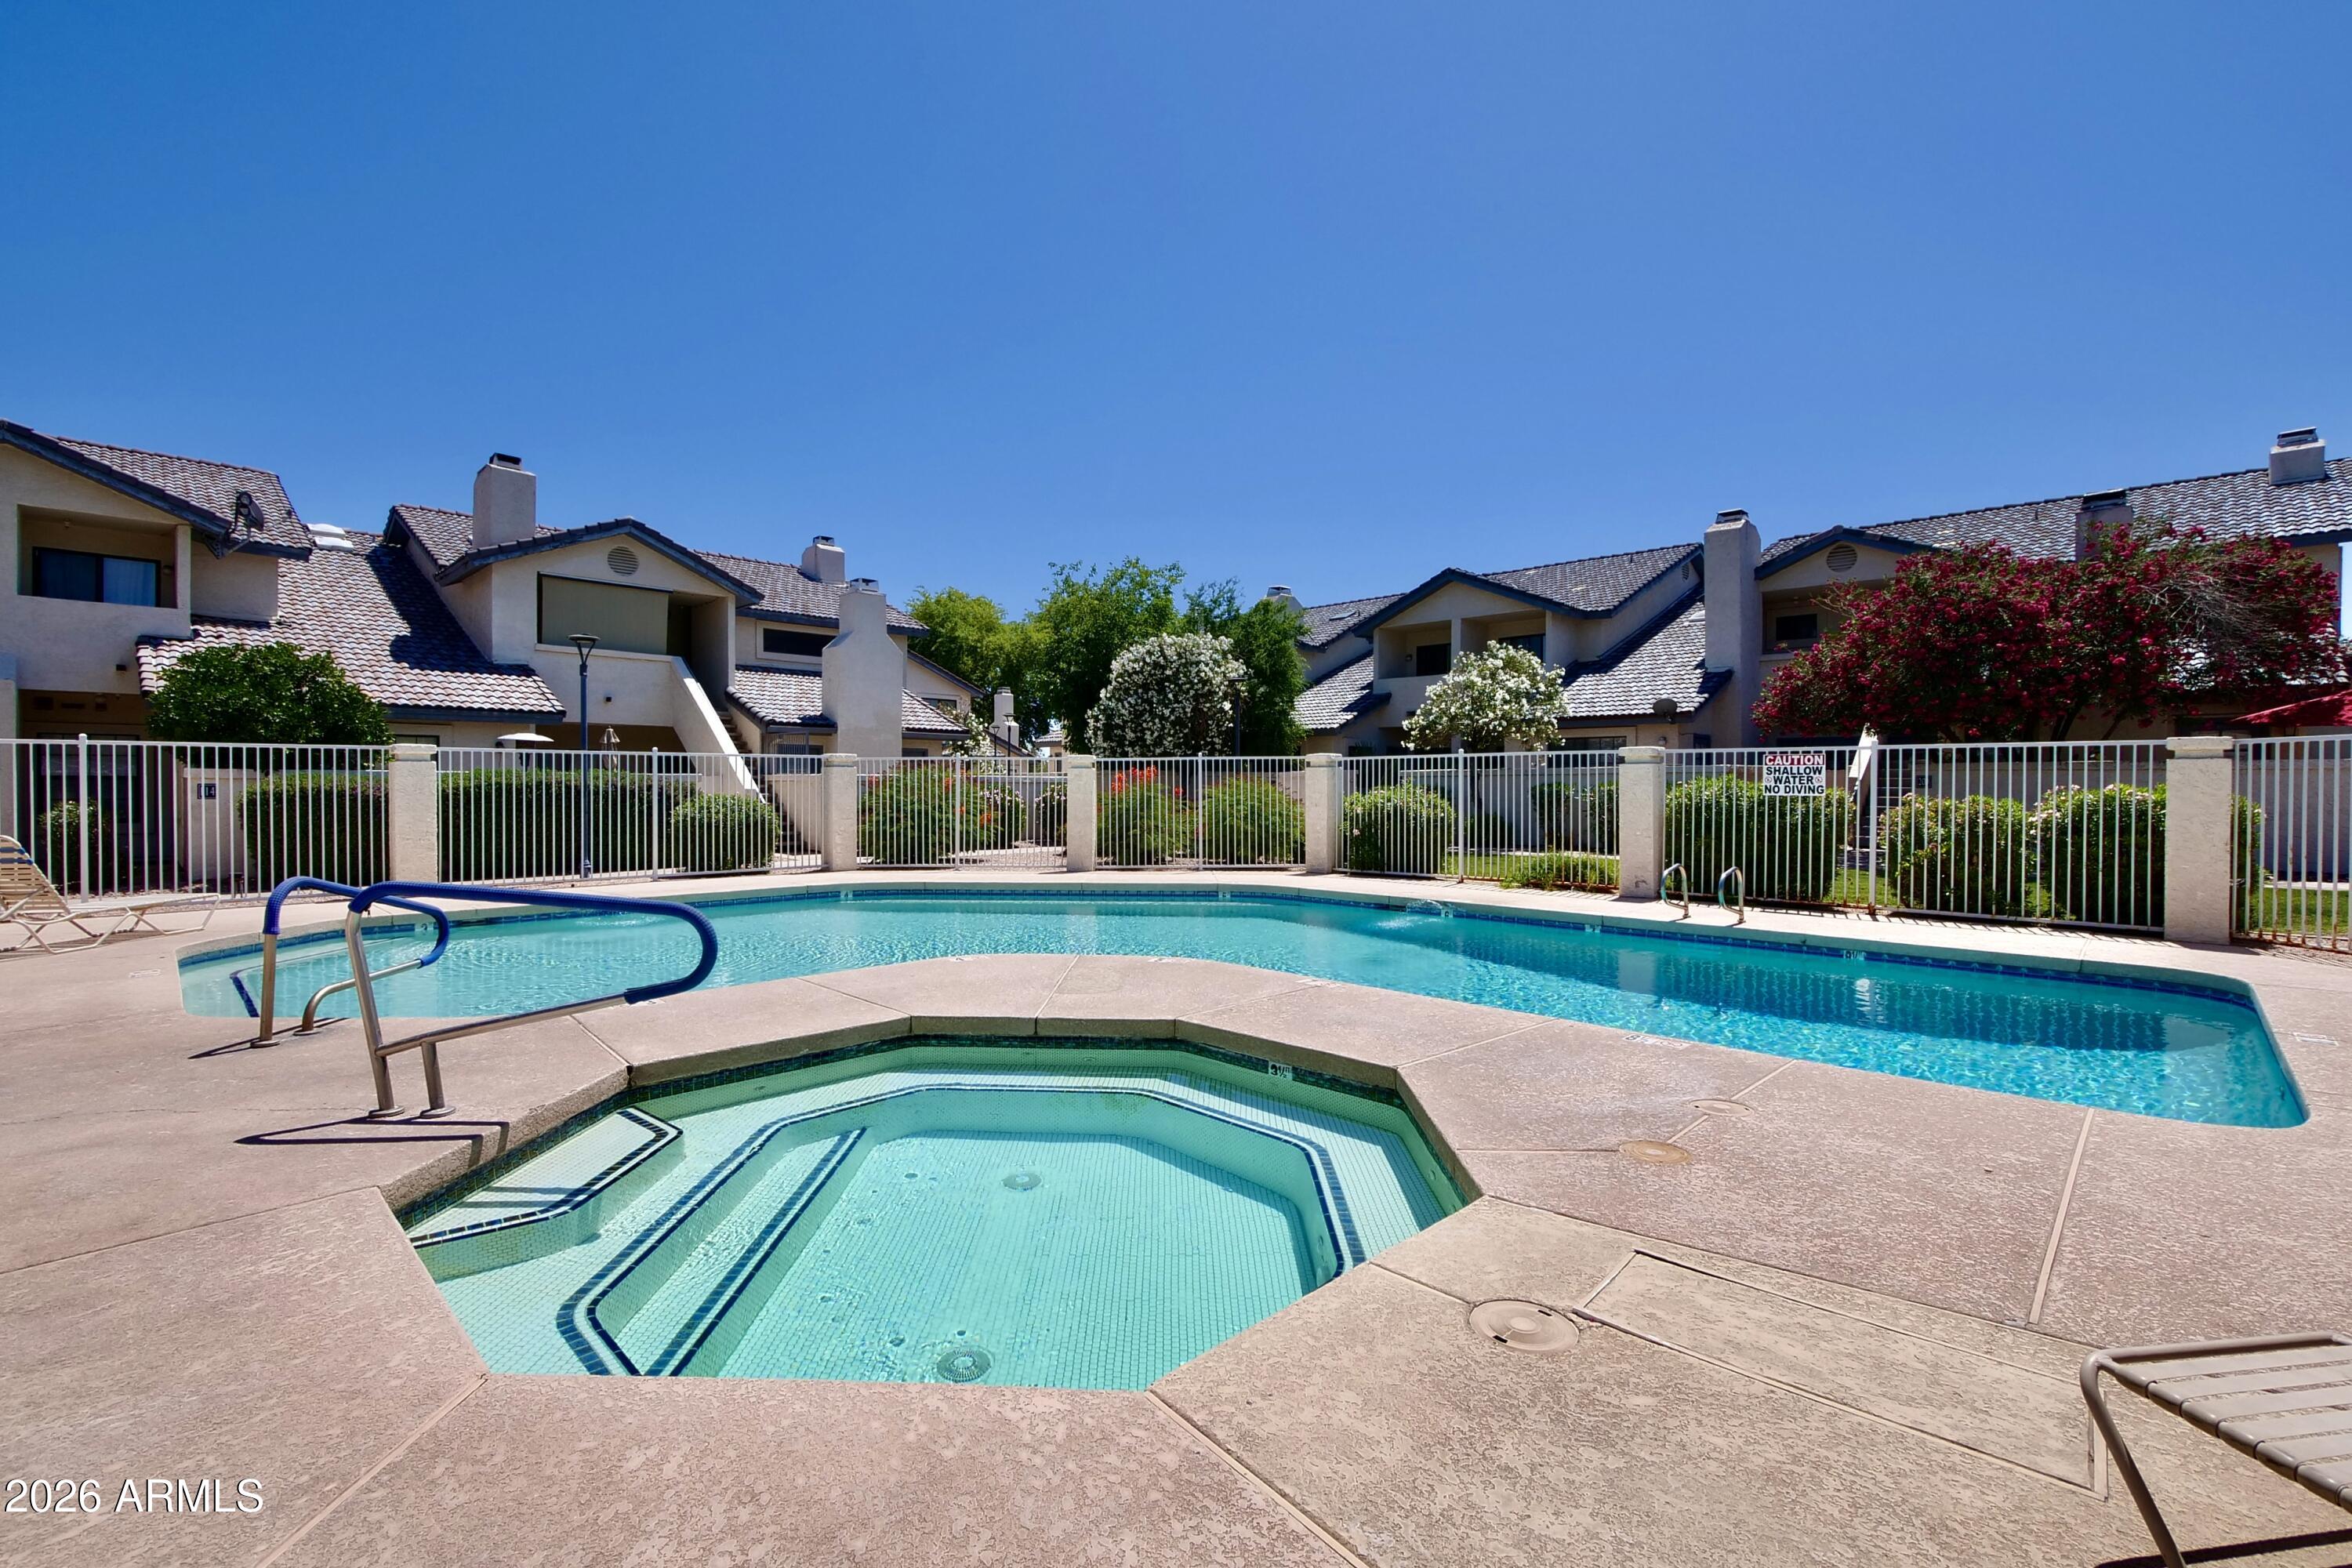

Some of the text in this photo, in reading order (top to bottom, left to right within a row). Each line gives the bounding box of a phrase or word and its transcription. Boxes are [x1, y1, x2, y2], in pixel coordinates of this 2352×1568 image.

[1766, 755, 1824, 765] CAUTION
[1766, 766, 1823, 775] SHALLOW
[1773, 775, 1814, 785] WATER
[1765, 785, 1824, 794] NO DIVING
